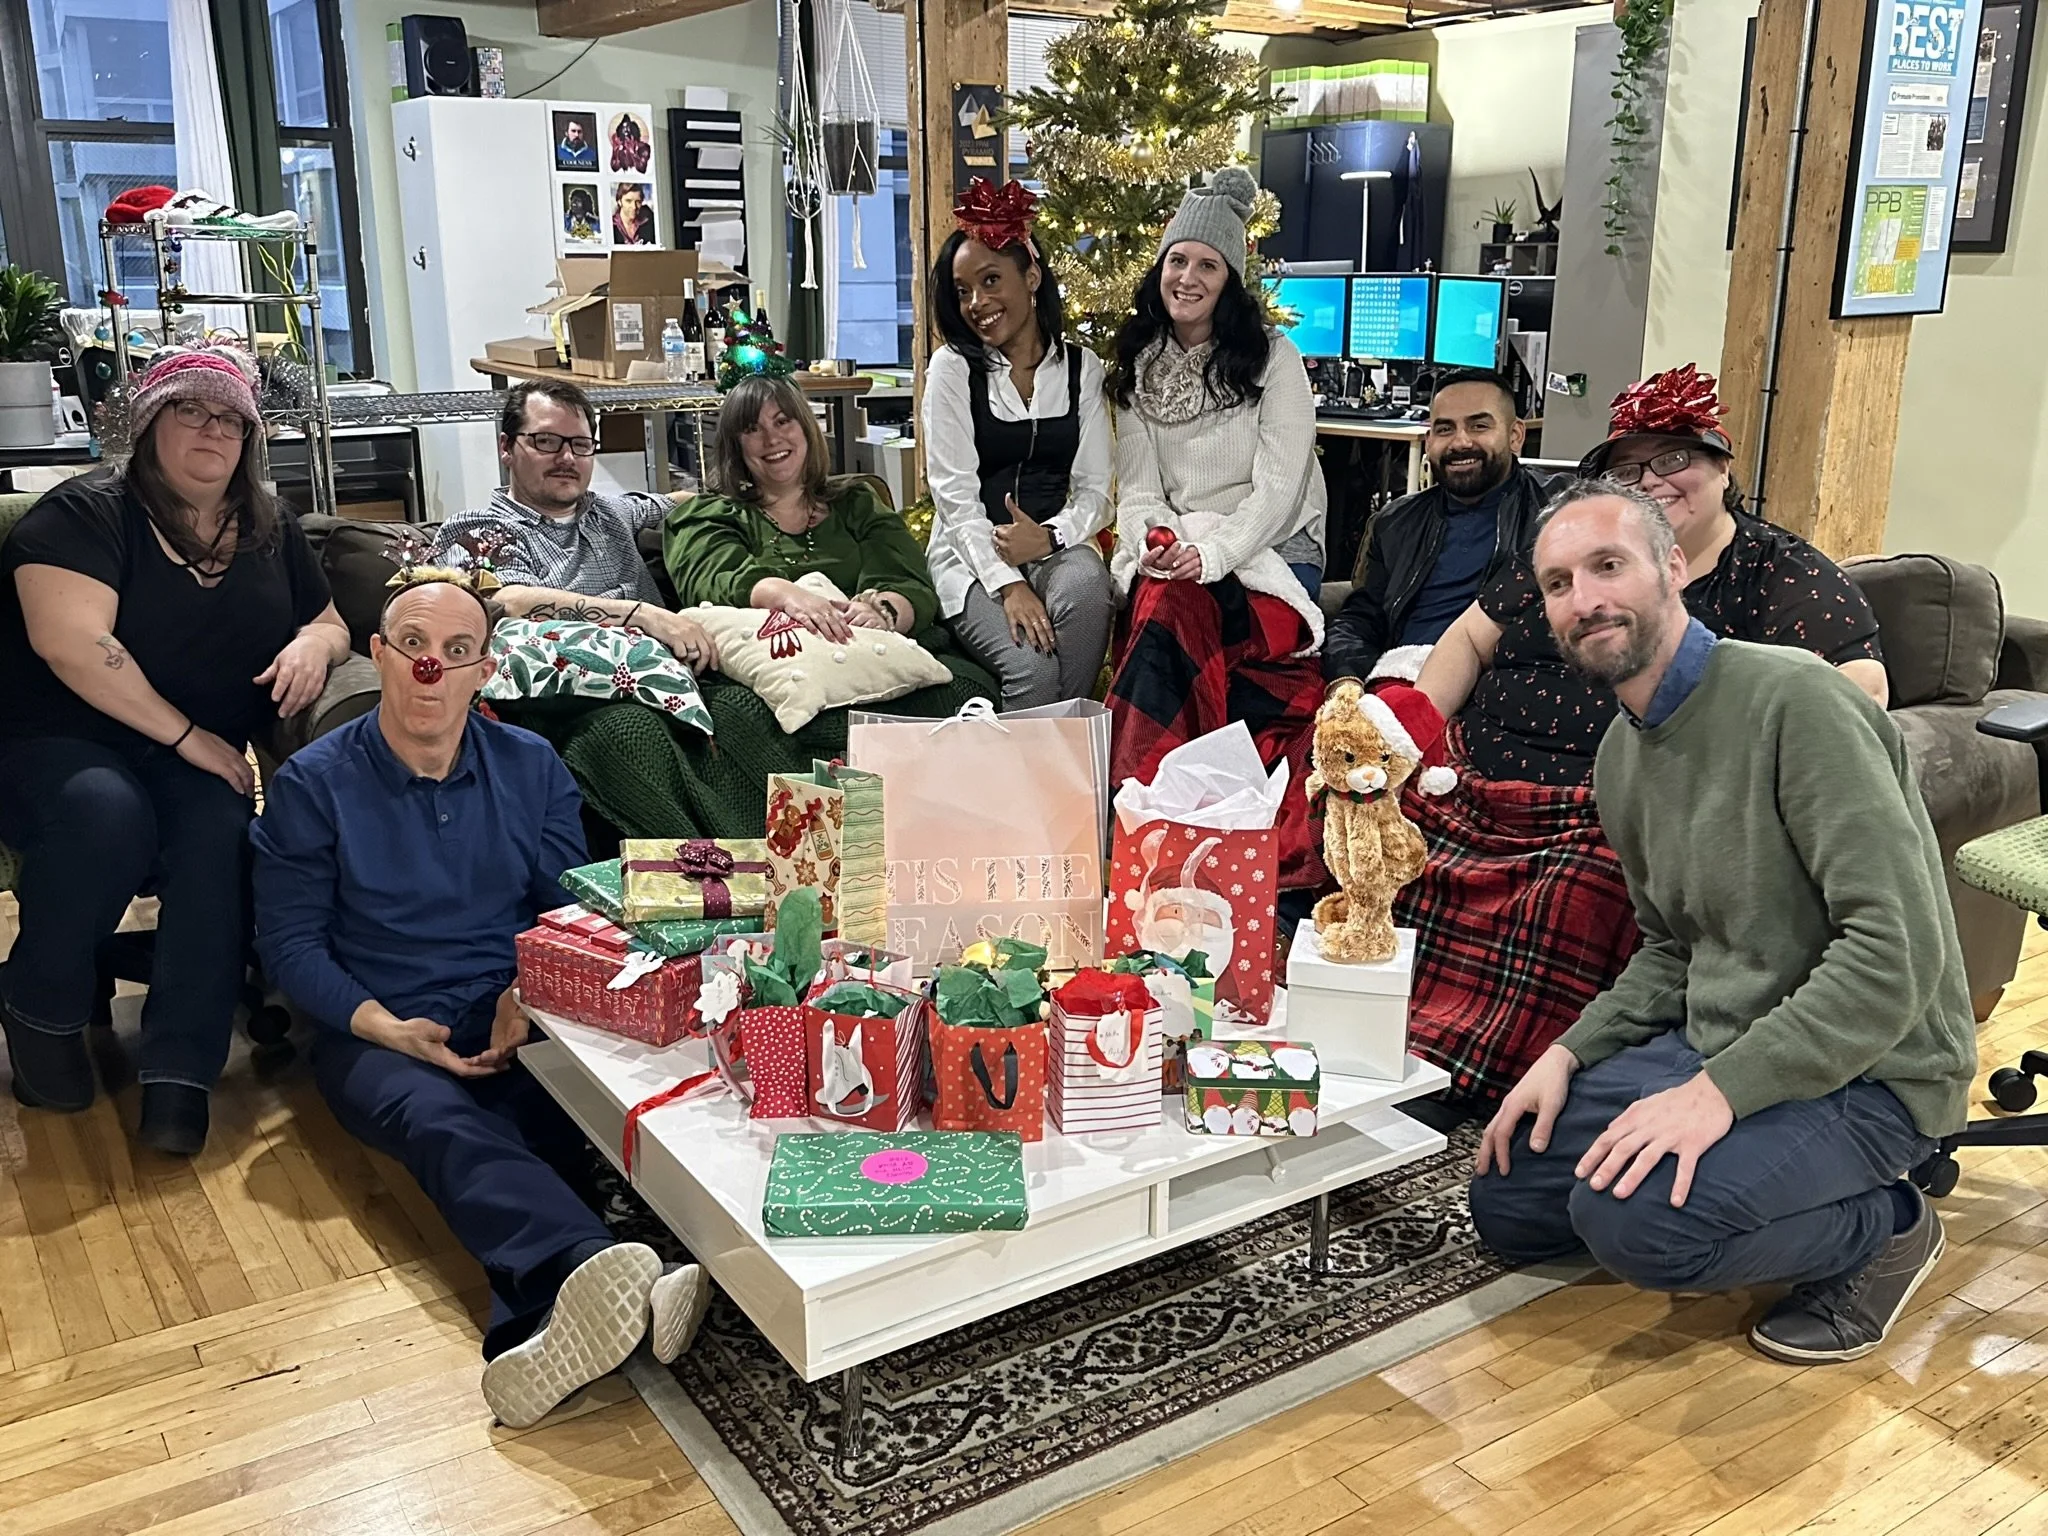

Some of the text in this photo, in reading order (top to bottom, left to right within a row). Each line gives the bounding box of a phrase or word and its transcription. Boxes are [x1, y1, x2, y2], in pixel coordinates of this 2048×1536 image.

[1889, 3, 1964, 60] BEST
[1892, 58, 1953, 72] PLACES TO WORK
[1865, 191, 1902, 213] PPB
[971, 853, 1095, 904] THE
[889, 910, 1100, 966] EASON
